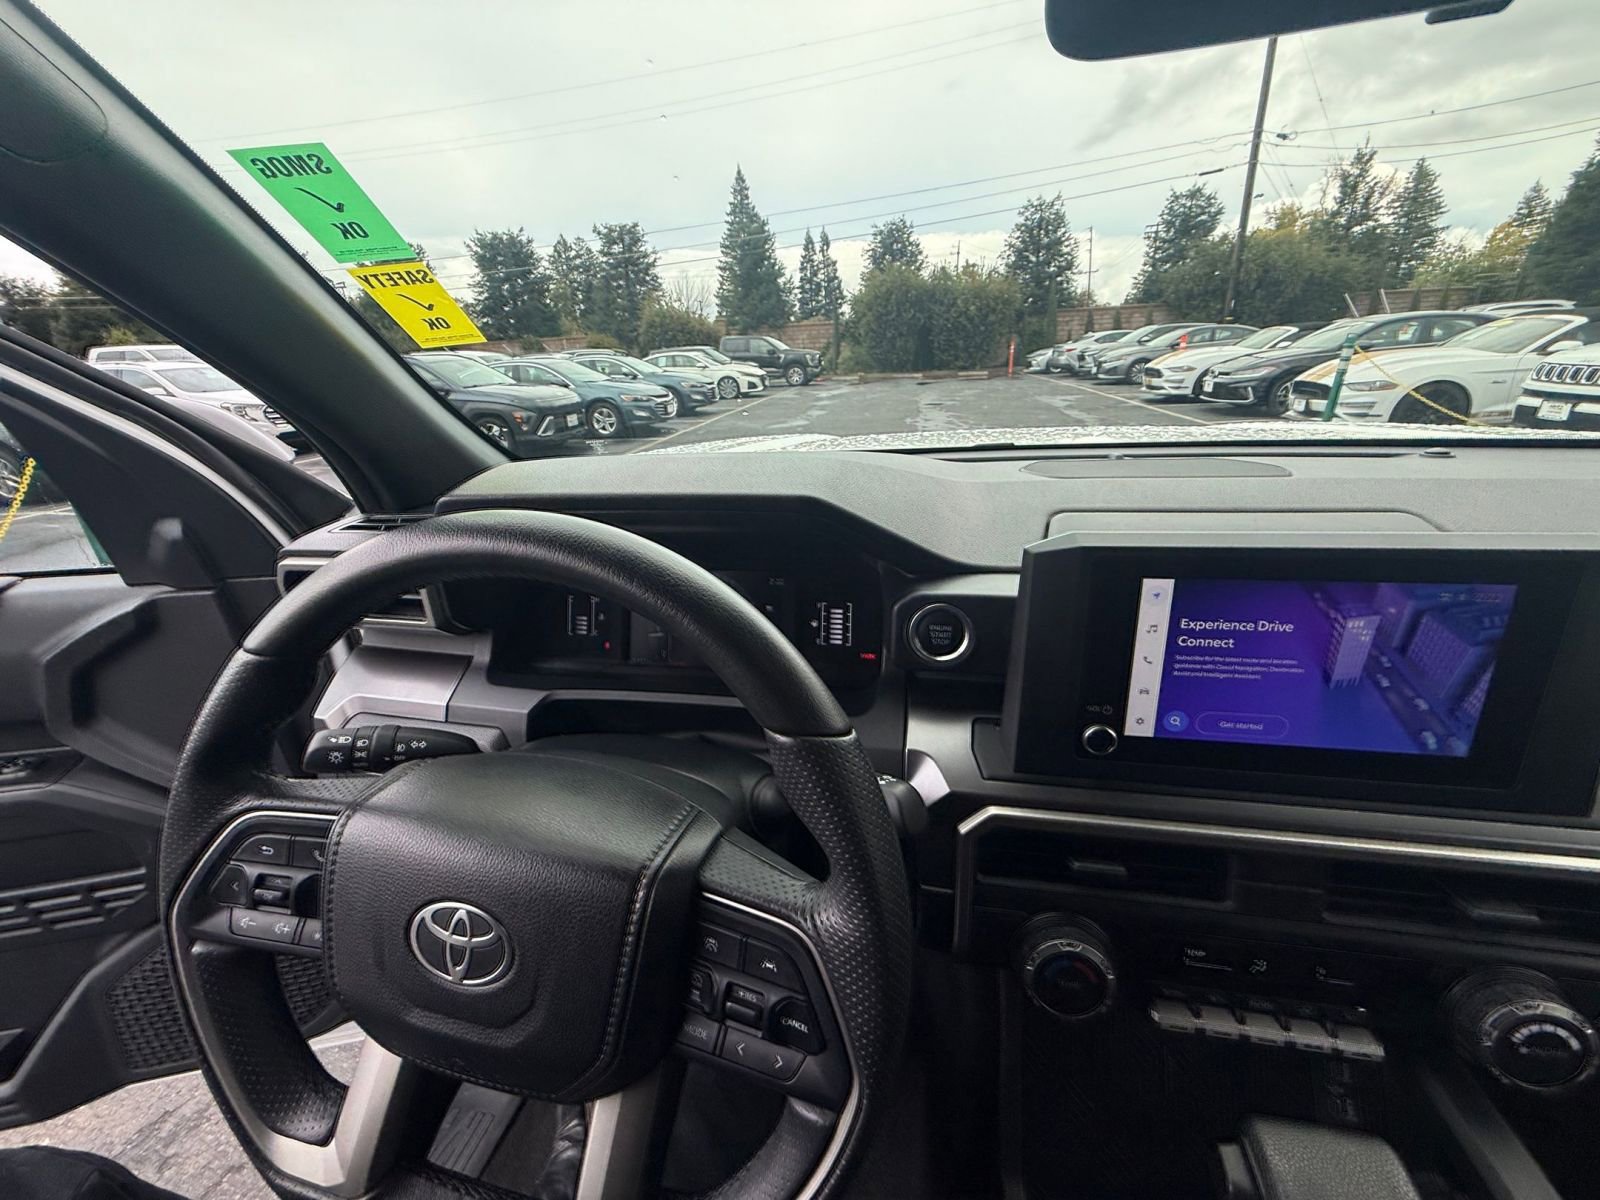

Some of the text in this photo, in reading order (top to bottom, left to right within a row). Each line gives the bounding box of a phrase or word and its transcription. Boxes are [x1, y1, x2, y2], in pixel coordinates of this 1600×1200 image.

[1180, 618, 1294, 632] Experience Drive
[1177, 635, 1235, 648] Connect
[1219, 720, 1263, 730] Get started
